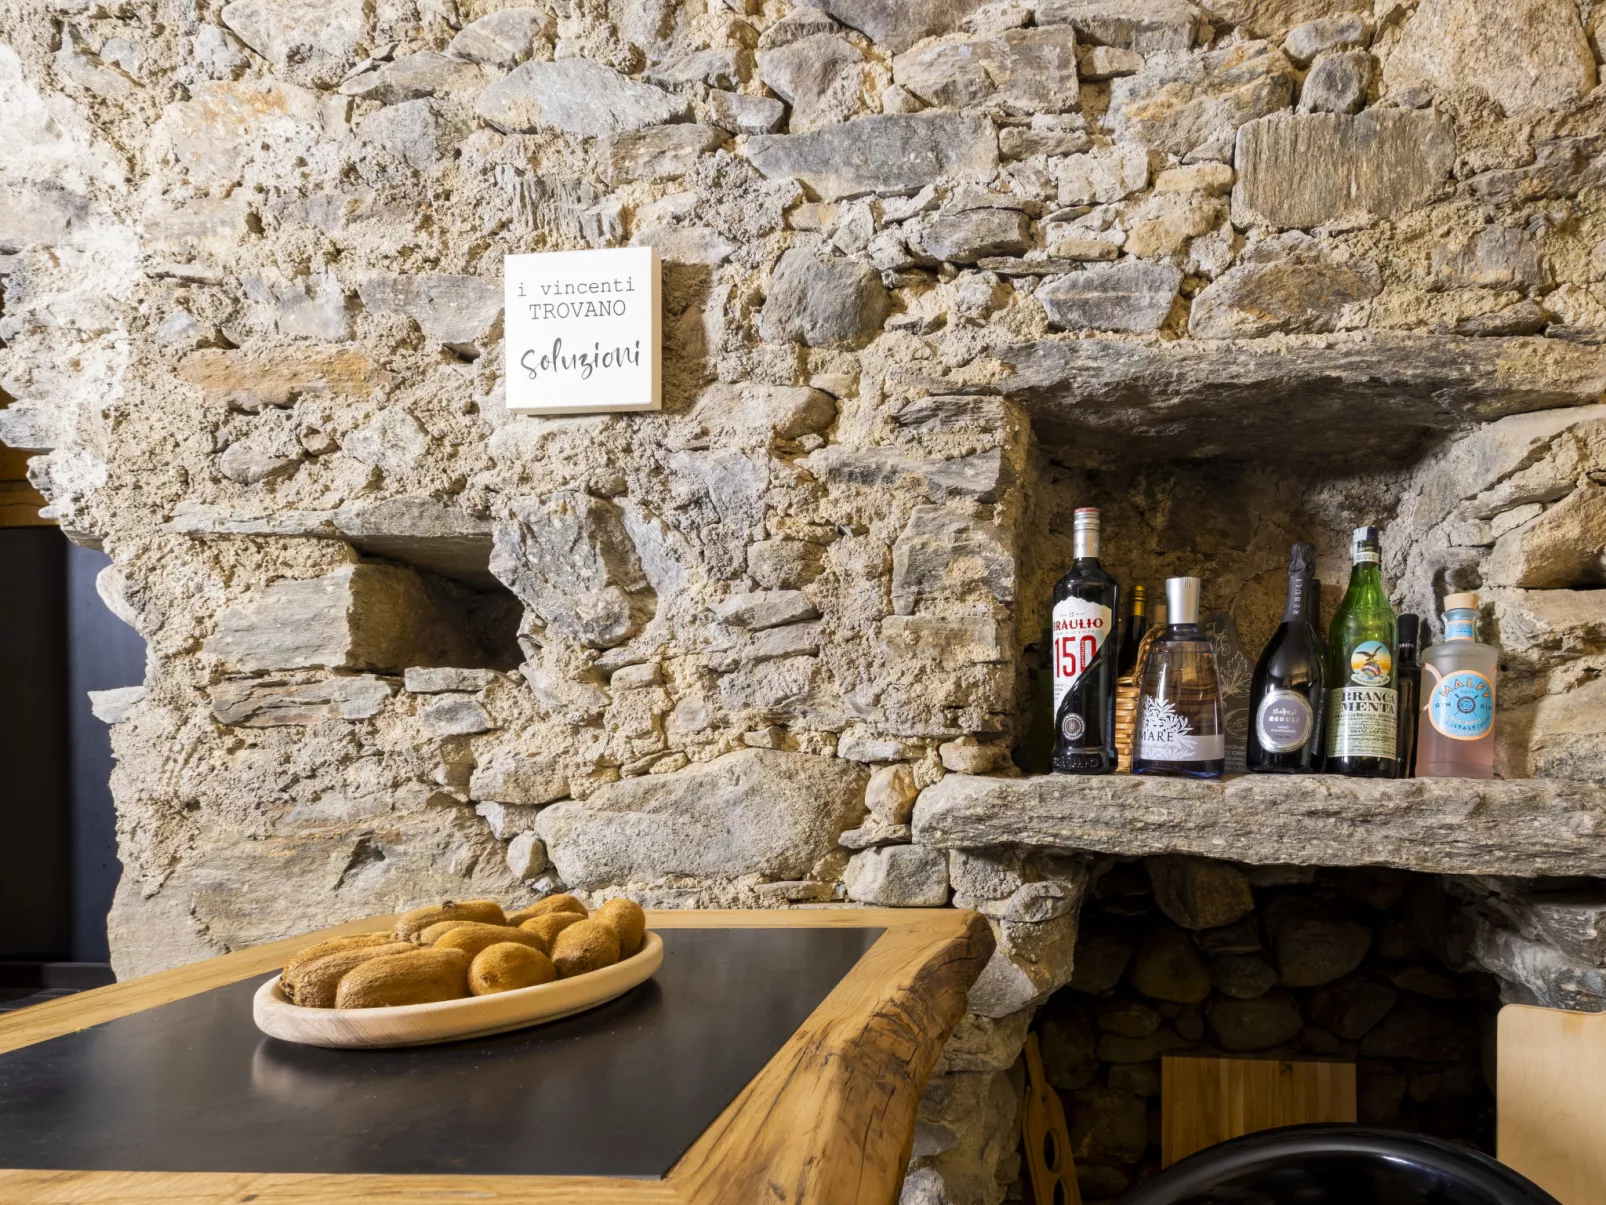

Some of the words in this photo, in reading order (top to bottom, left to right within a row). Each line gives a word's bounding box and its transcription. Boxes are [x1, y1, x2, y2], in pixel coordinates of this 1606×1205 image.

[518, 282, 527, 297] i
[541, 276, 635, 296] vincenti
[529, 299, 626, 320] TROVANO
[1292, 577, 1304, 615] REBULI
[1055, 635, 1097, 678] 150
[1342, 691, 1395, 705] BRANCA
[1439, 677, 1491, 698] MALFY
[1341, 702, 1395, 715] MENTA
